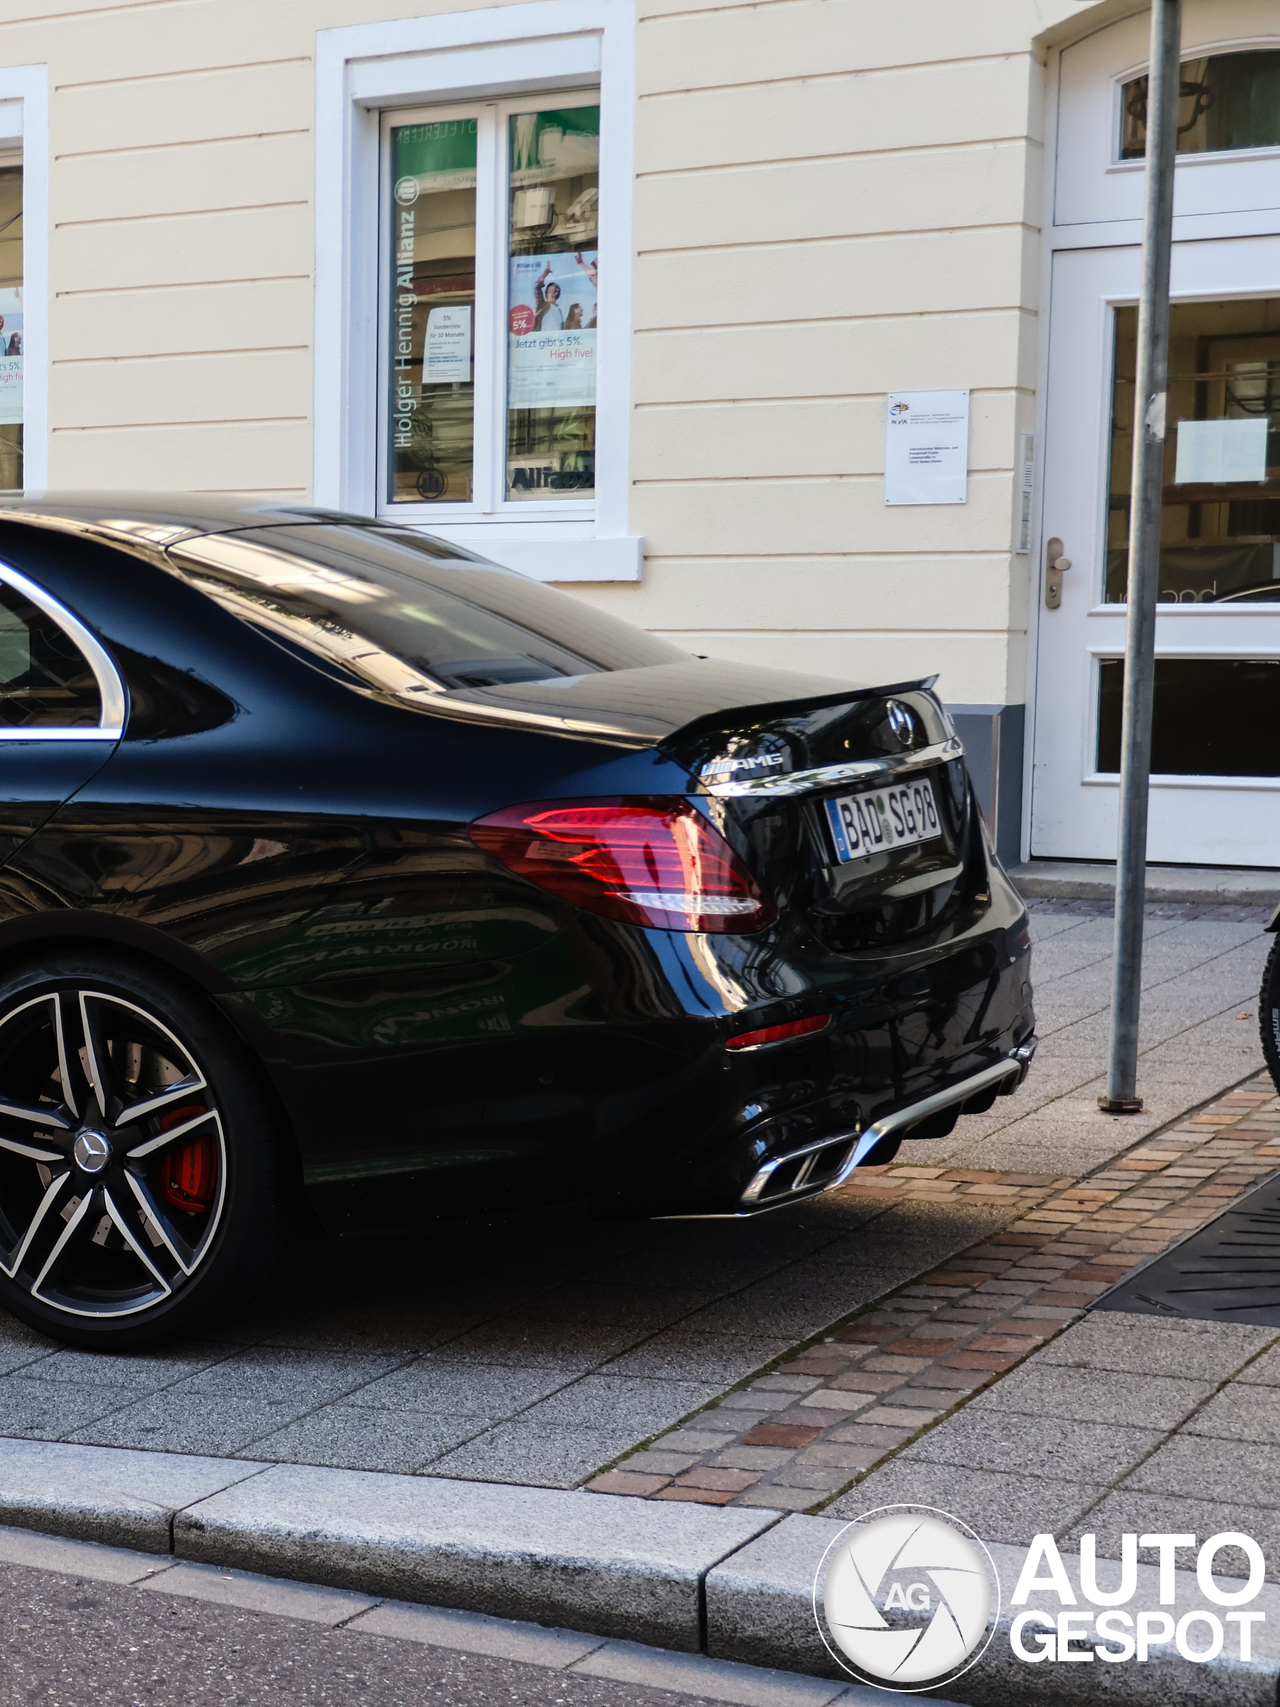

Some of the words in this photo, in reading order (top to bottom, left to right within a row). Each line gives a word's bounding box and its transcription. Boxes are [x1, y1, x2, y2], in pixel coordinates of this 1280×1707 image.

[397, 210, 415, 289] Allianz
[394, 291, 417, 371] Hennig
[513, 320, 527, 330] 5%
[515, 339, 536, 349] Jetzt
[550, 349, 572, 360] High
[574, 348, 594, 357] five!
[393, 376, 417, 448] Holger
[731, 752, 784, 771] AMG
[840, 796, 883, 850] BAD
